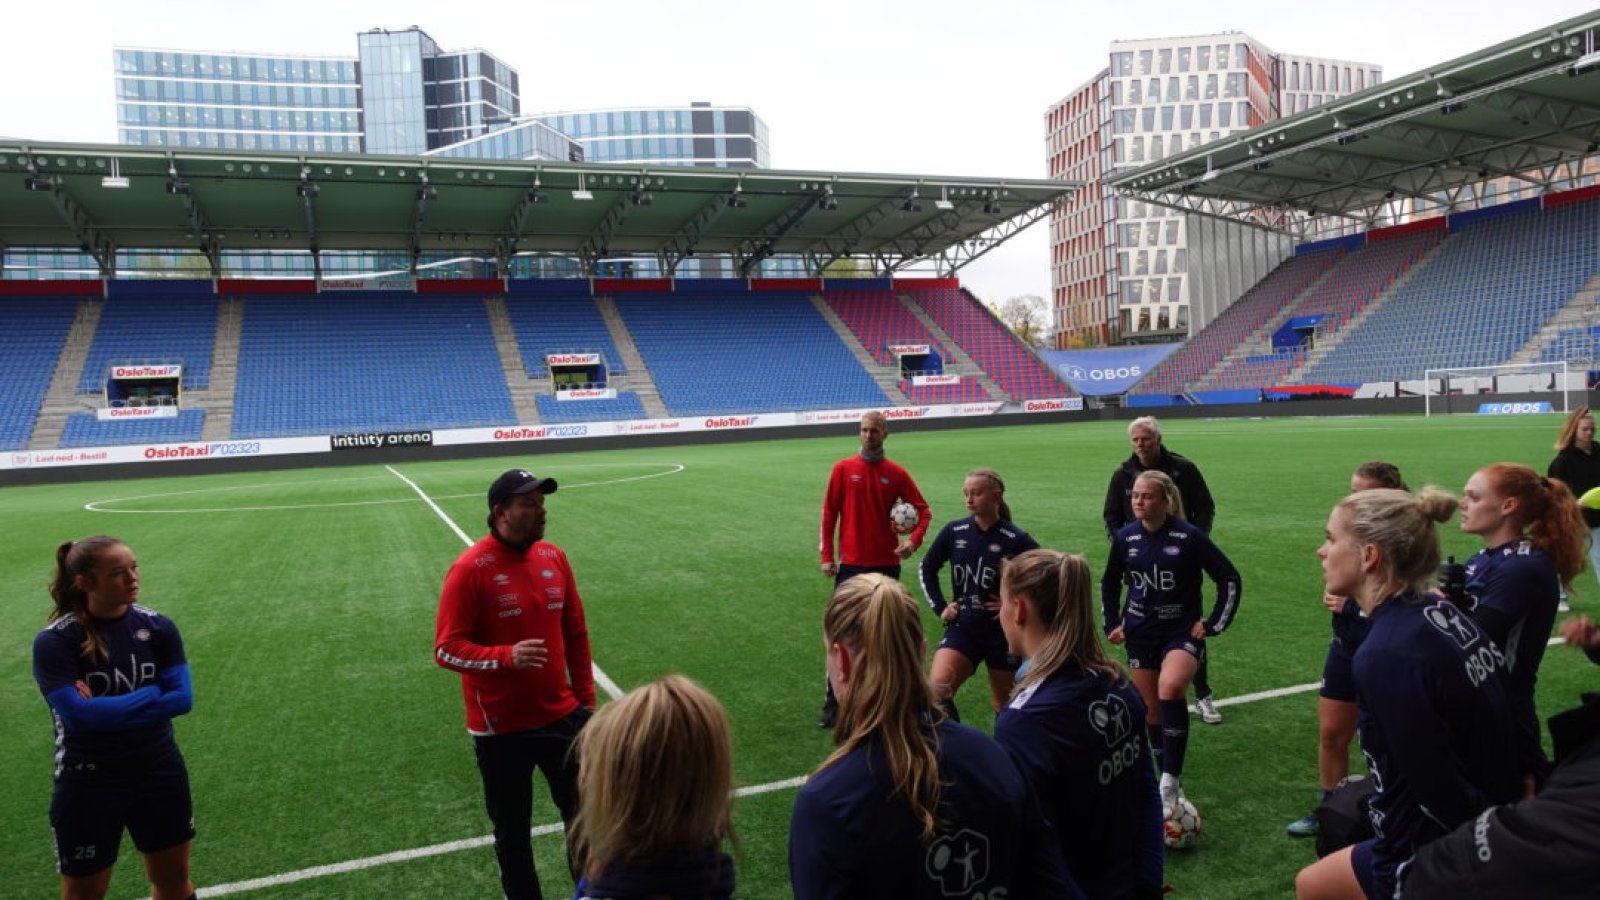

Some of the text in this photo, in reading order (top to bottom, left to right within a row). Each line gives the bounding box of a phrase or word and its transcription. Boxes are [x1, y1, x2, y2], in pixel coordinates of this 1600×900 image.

[116, 367, 168, 377] OsloTaxi
[1089, 366, 1142, 380] OBOS
[1502, 403, 1541, 414] OBOS
[705, 416, 749, 429] OsloTaxi
[332, 431, 432, 447] intility arena
[494, 425, 588, 440] OsloTaxi 02323
[144, 442, 261, 459] OsloTaxi 02323
[953, 556, 997, 593] DNB
[1129, 563, 1177, 598] DNB
[1465, 641, 1505, 687] OBOS
[1098, 734, 1141, 785] OBOS
[74, 845, 96, 860] 25
